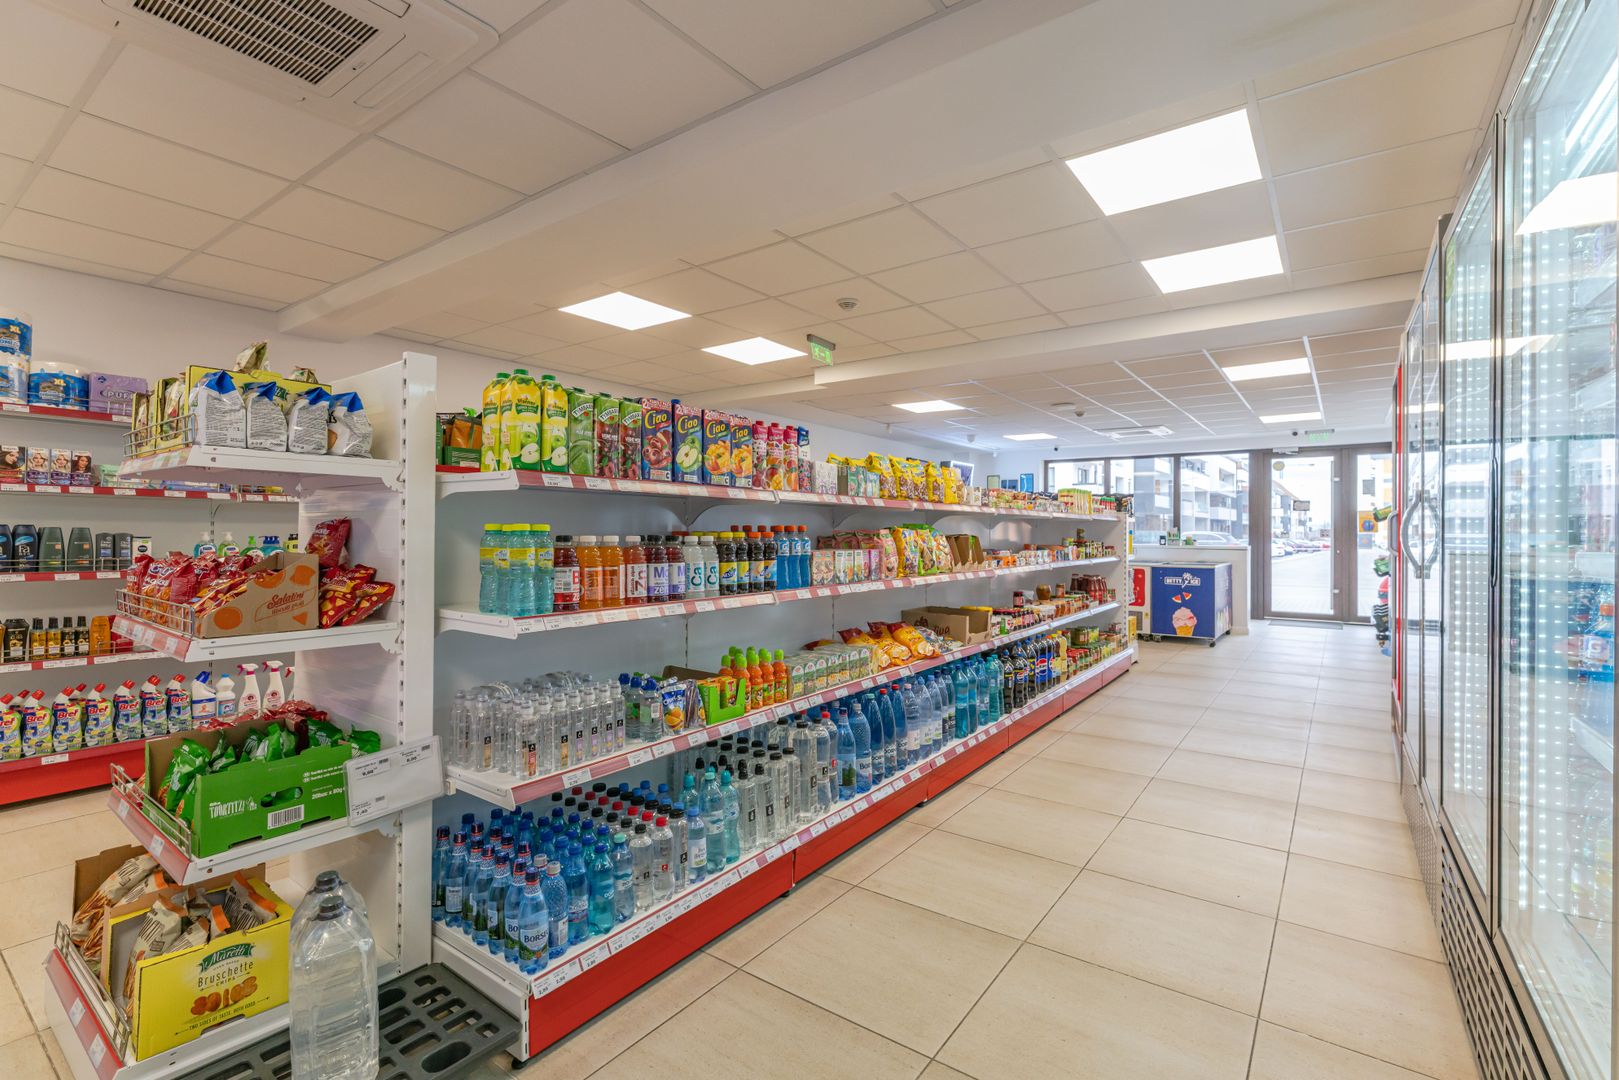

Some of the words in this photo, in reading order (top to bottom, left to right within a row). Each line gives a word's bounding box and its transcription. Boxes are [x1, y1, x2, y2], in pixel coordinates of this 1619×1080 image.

[644, 410, 667, 429] Ciao
[677, 415, 698, 434] Ciao
[706, 421, 726, 438] Ciao
[19, 545, 30, 554] Fa
[690, 567, 703, 587] Ca
[706, 566, 718, 585] Ca
[146, 698, 164, 707] Bref
[171, 695, 189, 703] Bref
[89, 705, 108, 715] Bref
[120, 700, 139, 710] Bref
[27, 713, 47, 723] Bref
[57, 708, 78, 719] Bref
[0, 717, 15, 727] ref
[198, 961, 254, 988] Bruschette
[216, 976, 235, 987] CHIPS
